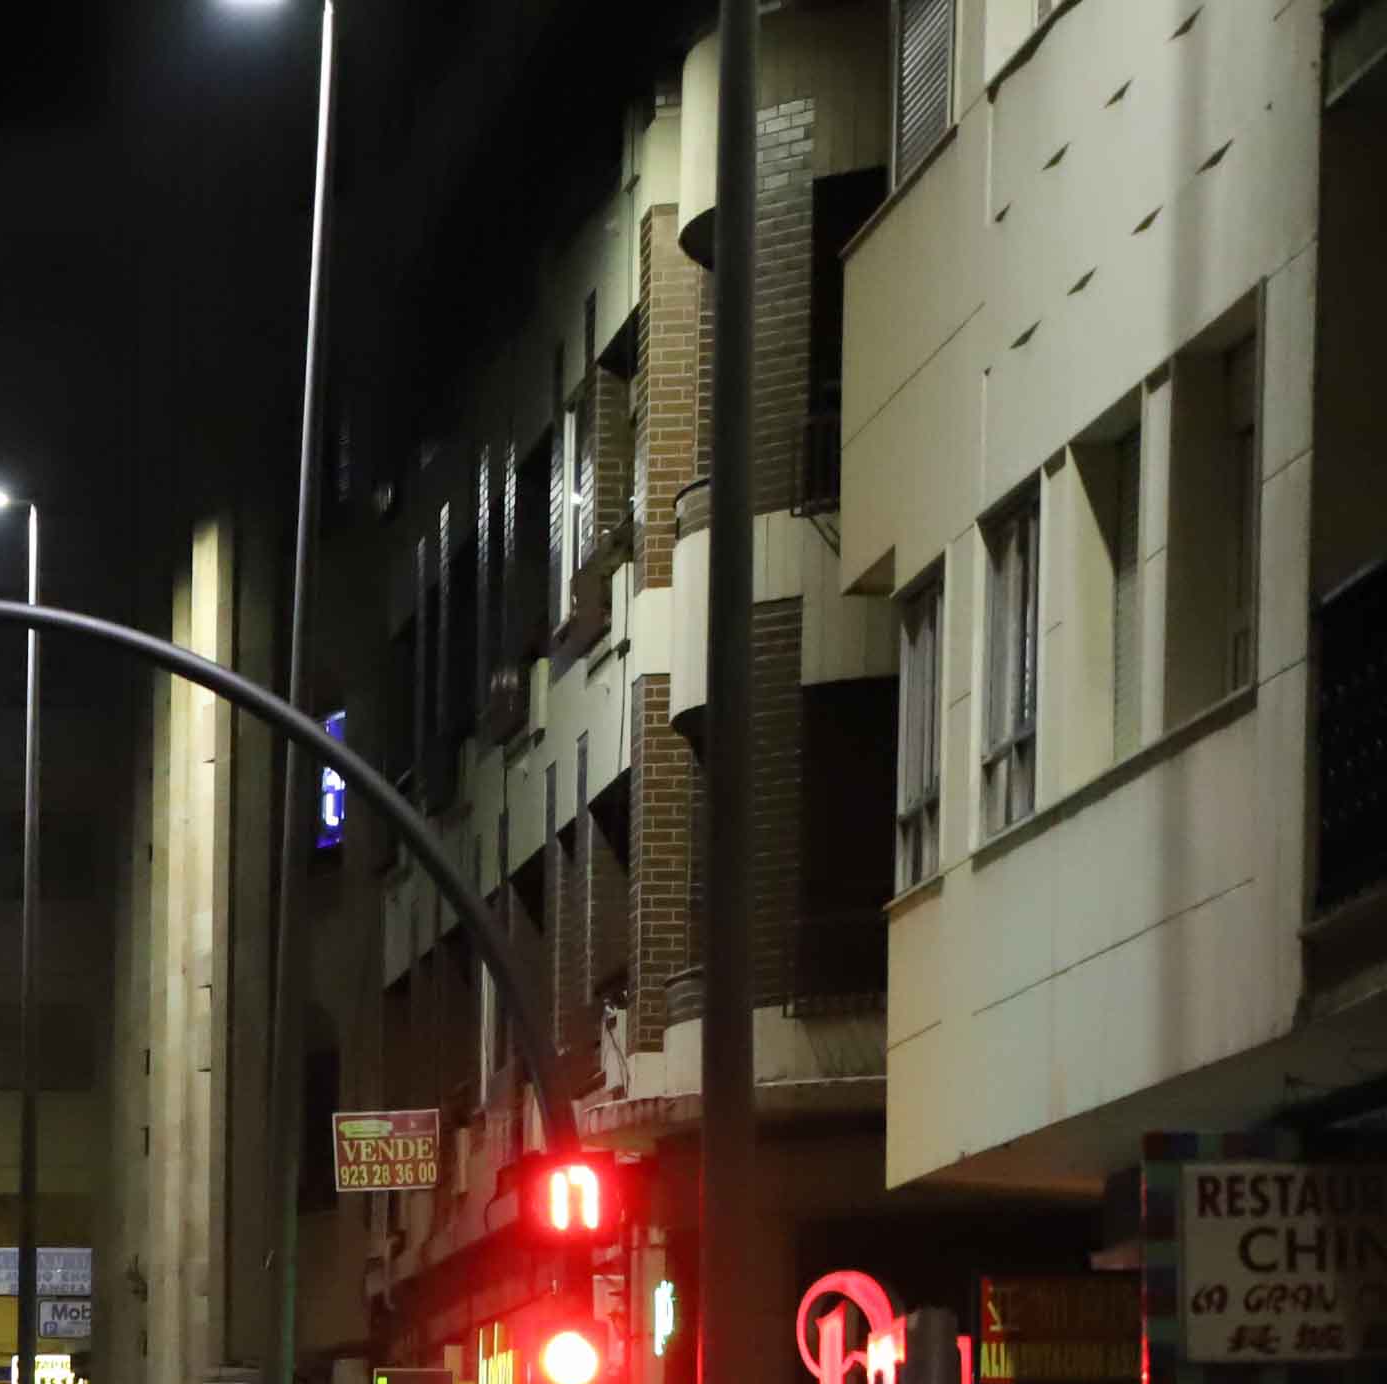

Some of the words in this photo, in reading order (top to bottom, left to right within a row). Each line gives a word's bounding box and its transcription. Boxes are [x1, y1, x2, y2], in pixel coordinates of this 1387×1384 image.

[340, 1137, 434, 1162] VENDE
[340, 1164, 368, 1186] 923
[372, 1163, 390, 1185] 28
[395, 1163, 413, 1184] 36
[419, 1161, 437, 1183] 00
